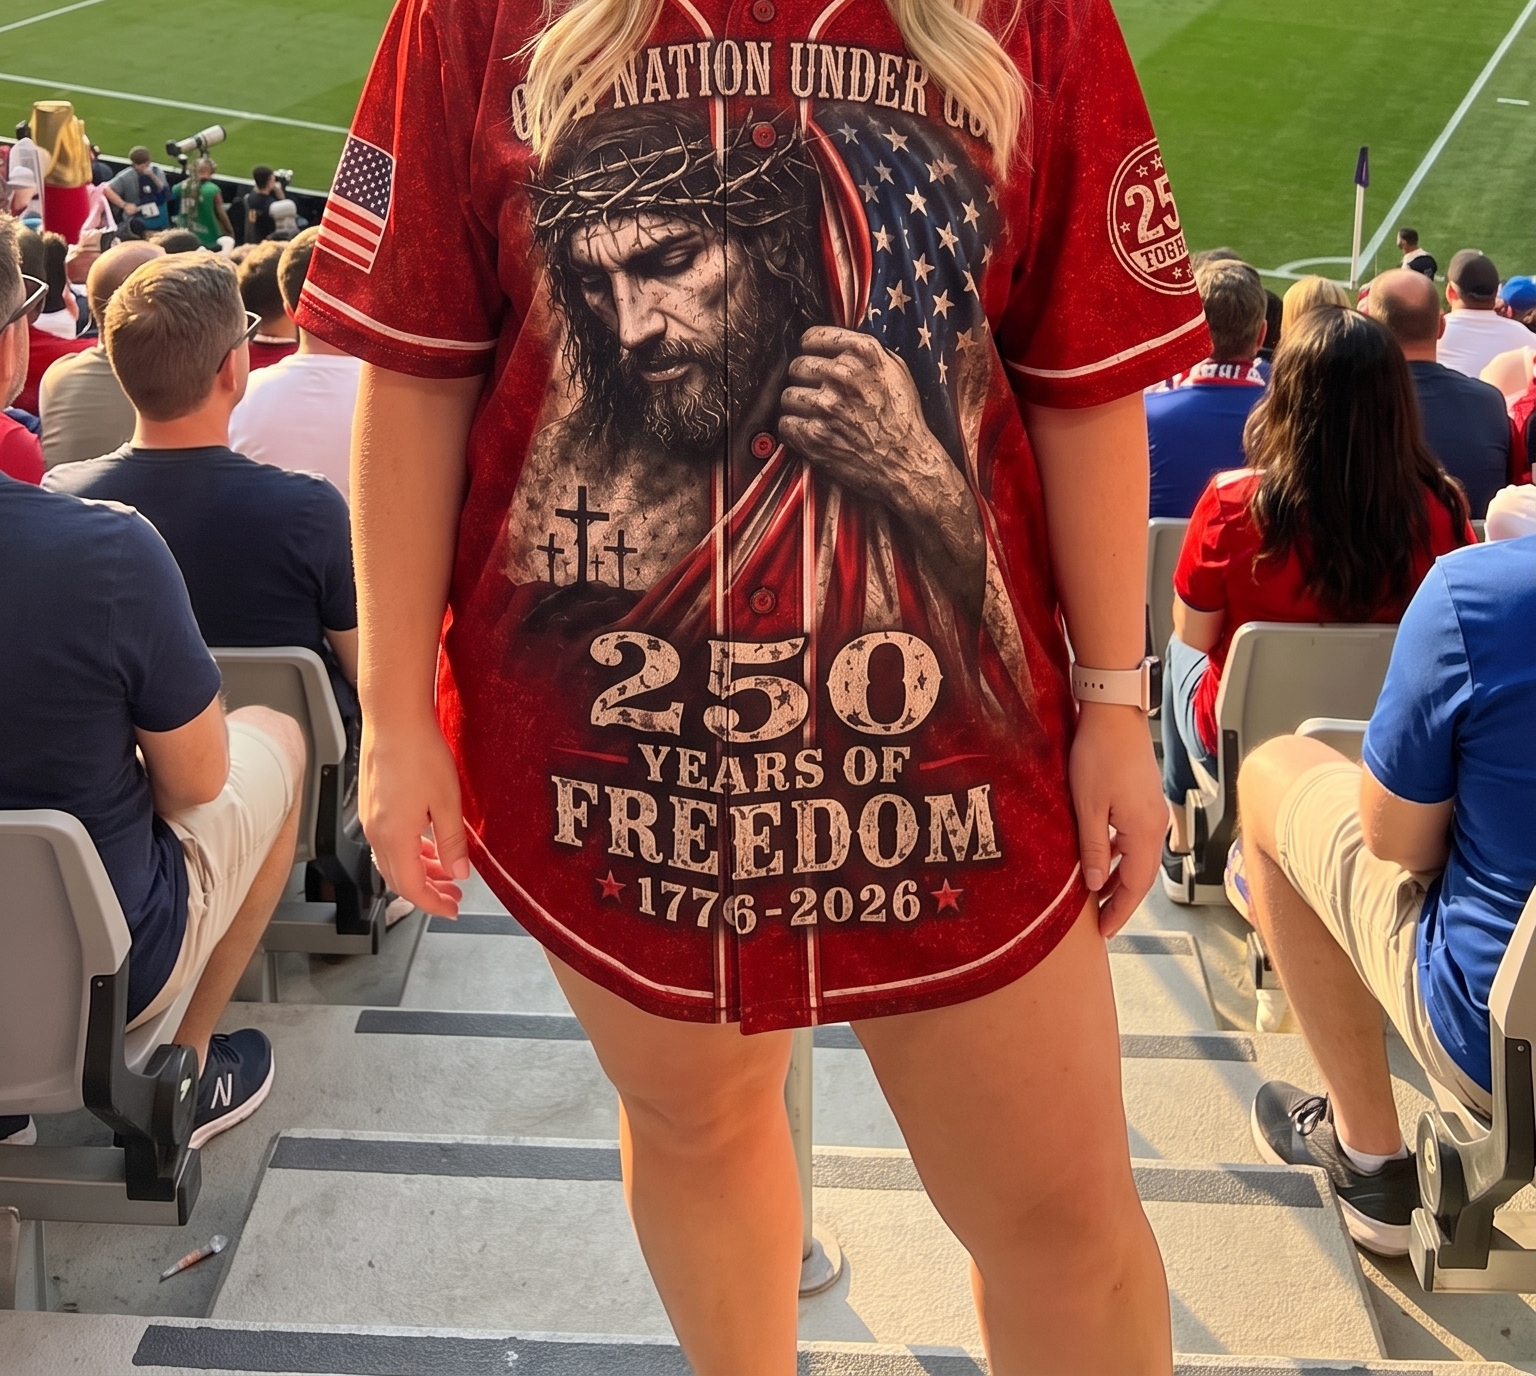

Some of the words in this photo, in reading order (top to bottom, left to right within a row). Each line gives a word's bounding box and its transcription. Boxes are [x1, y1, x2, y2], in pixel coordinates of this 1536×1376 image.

[613, 40, 772, 109] NATION
[790, 42, 929, 117] UNDER
[590, 631, 944, 744] 250
[637, 743, 825, 795] YEARS
[842, 746, 911, 787] OF
[551, 775, 1001, 880] FREEDOM
[637, 877, 921, 936] 1776-2026
[210, 1073, 233, 1110] N
